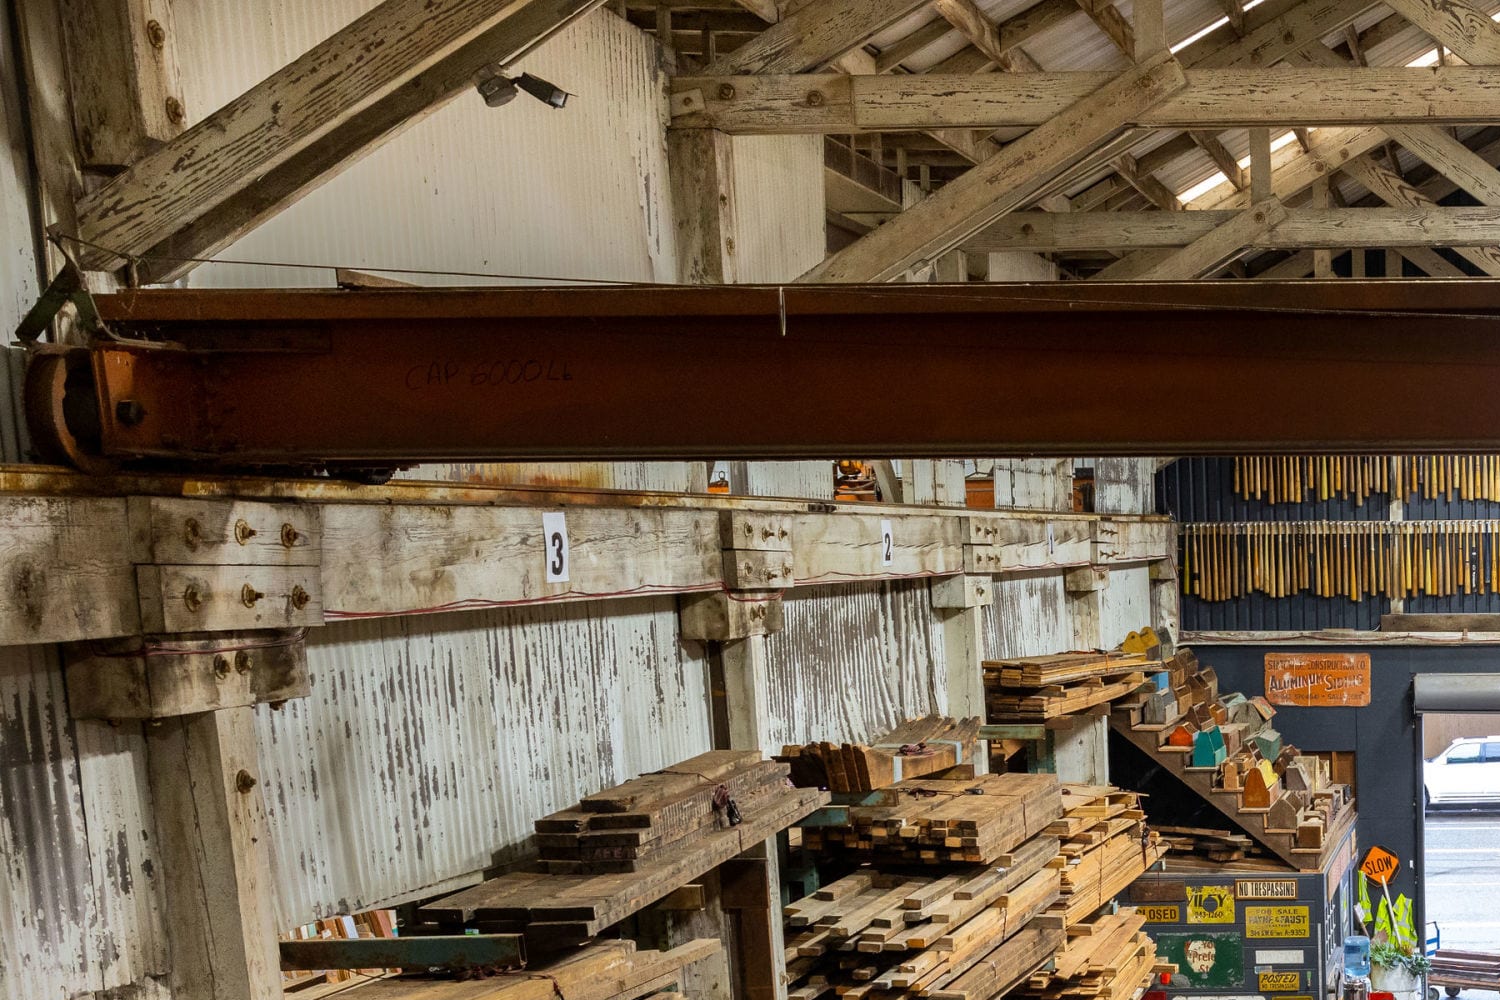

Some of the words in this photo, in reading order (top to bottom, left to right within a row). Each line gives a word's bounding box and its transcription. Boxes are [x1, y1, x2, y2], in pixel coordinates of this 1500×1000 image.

[405, 361, 459, 390] CAP
[551, 532, 563, 575] 3
[884, 533, 891, 561] 2
[1269, 673, 1323, 693] ALUMINUM
[1365, 856, 1392, 876] SLOW
[1239, 883, 1249, 897] NO
[1251, 883, 1295, 897] TRESPASSING
[1187, 894, 1227, 907] ILY
[1280, 915, 1306, 924] FAUST
[1261, 974, 1297, 983] POSTED
